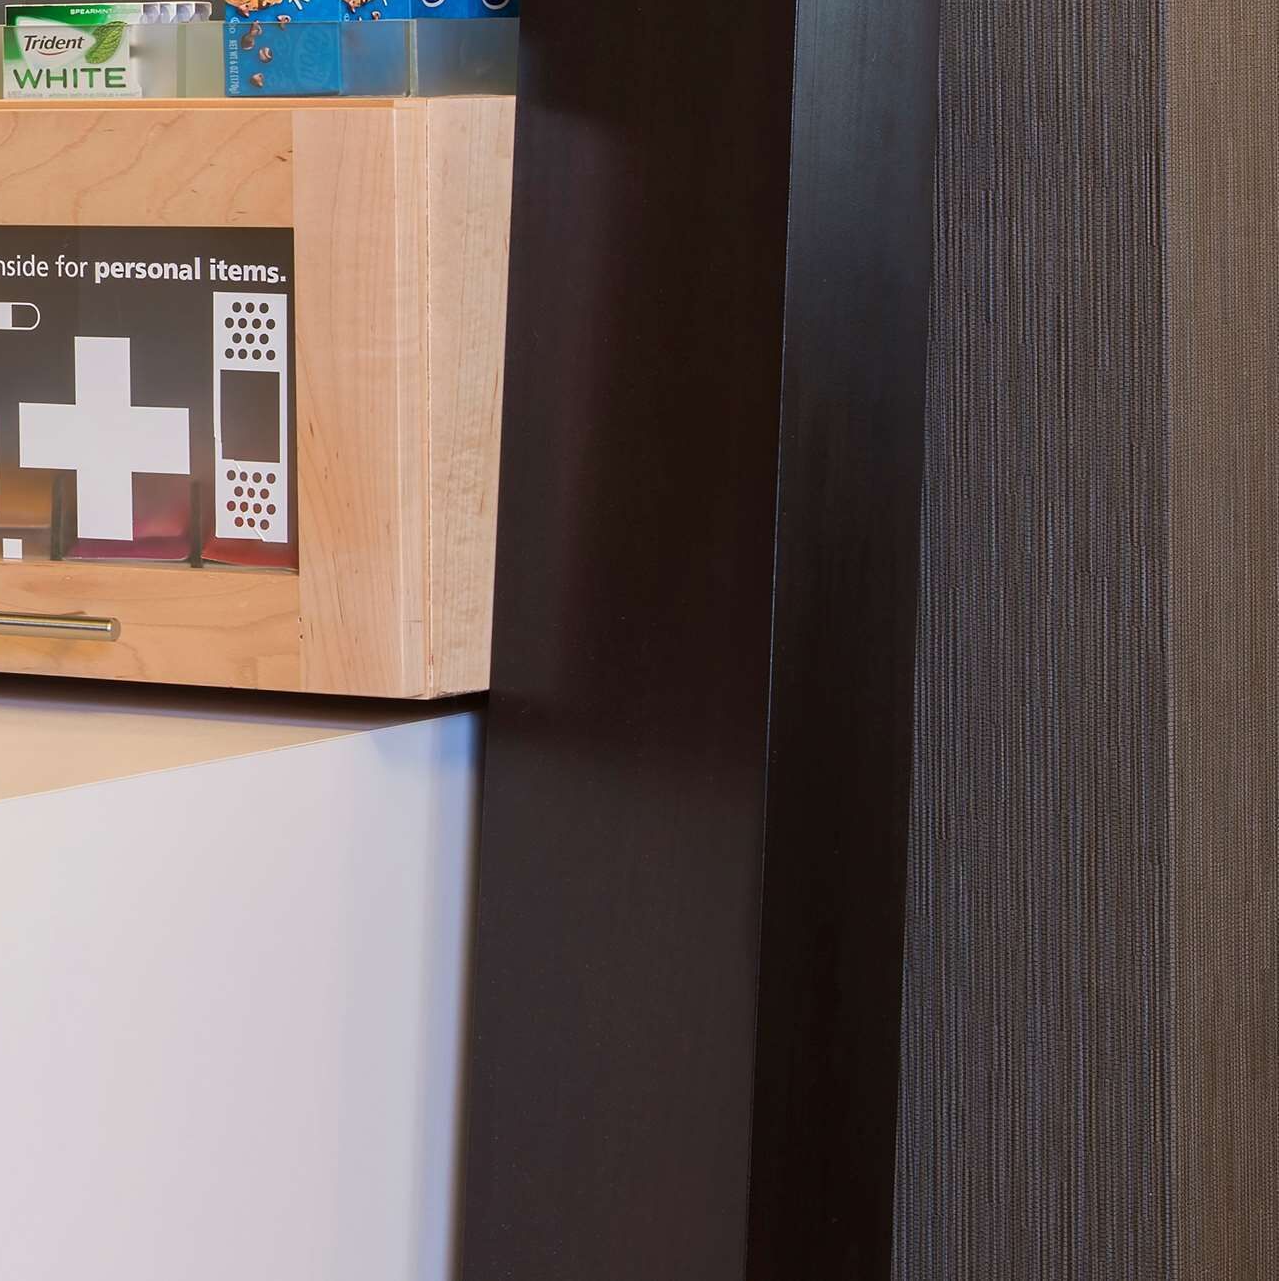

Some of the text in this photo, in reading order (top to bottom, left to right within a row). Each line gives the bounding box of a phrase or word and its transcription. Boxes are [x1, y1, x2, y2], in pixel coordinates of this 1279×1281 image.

[23, 35, 85, 52] Trident
[13, 68, 127, 89] WHITE
[55, 255, 88, 278] for
[95, 257, 201, 284] personal
[210, 258, 286, 284] items.
